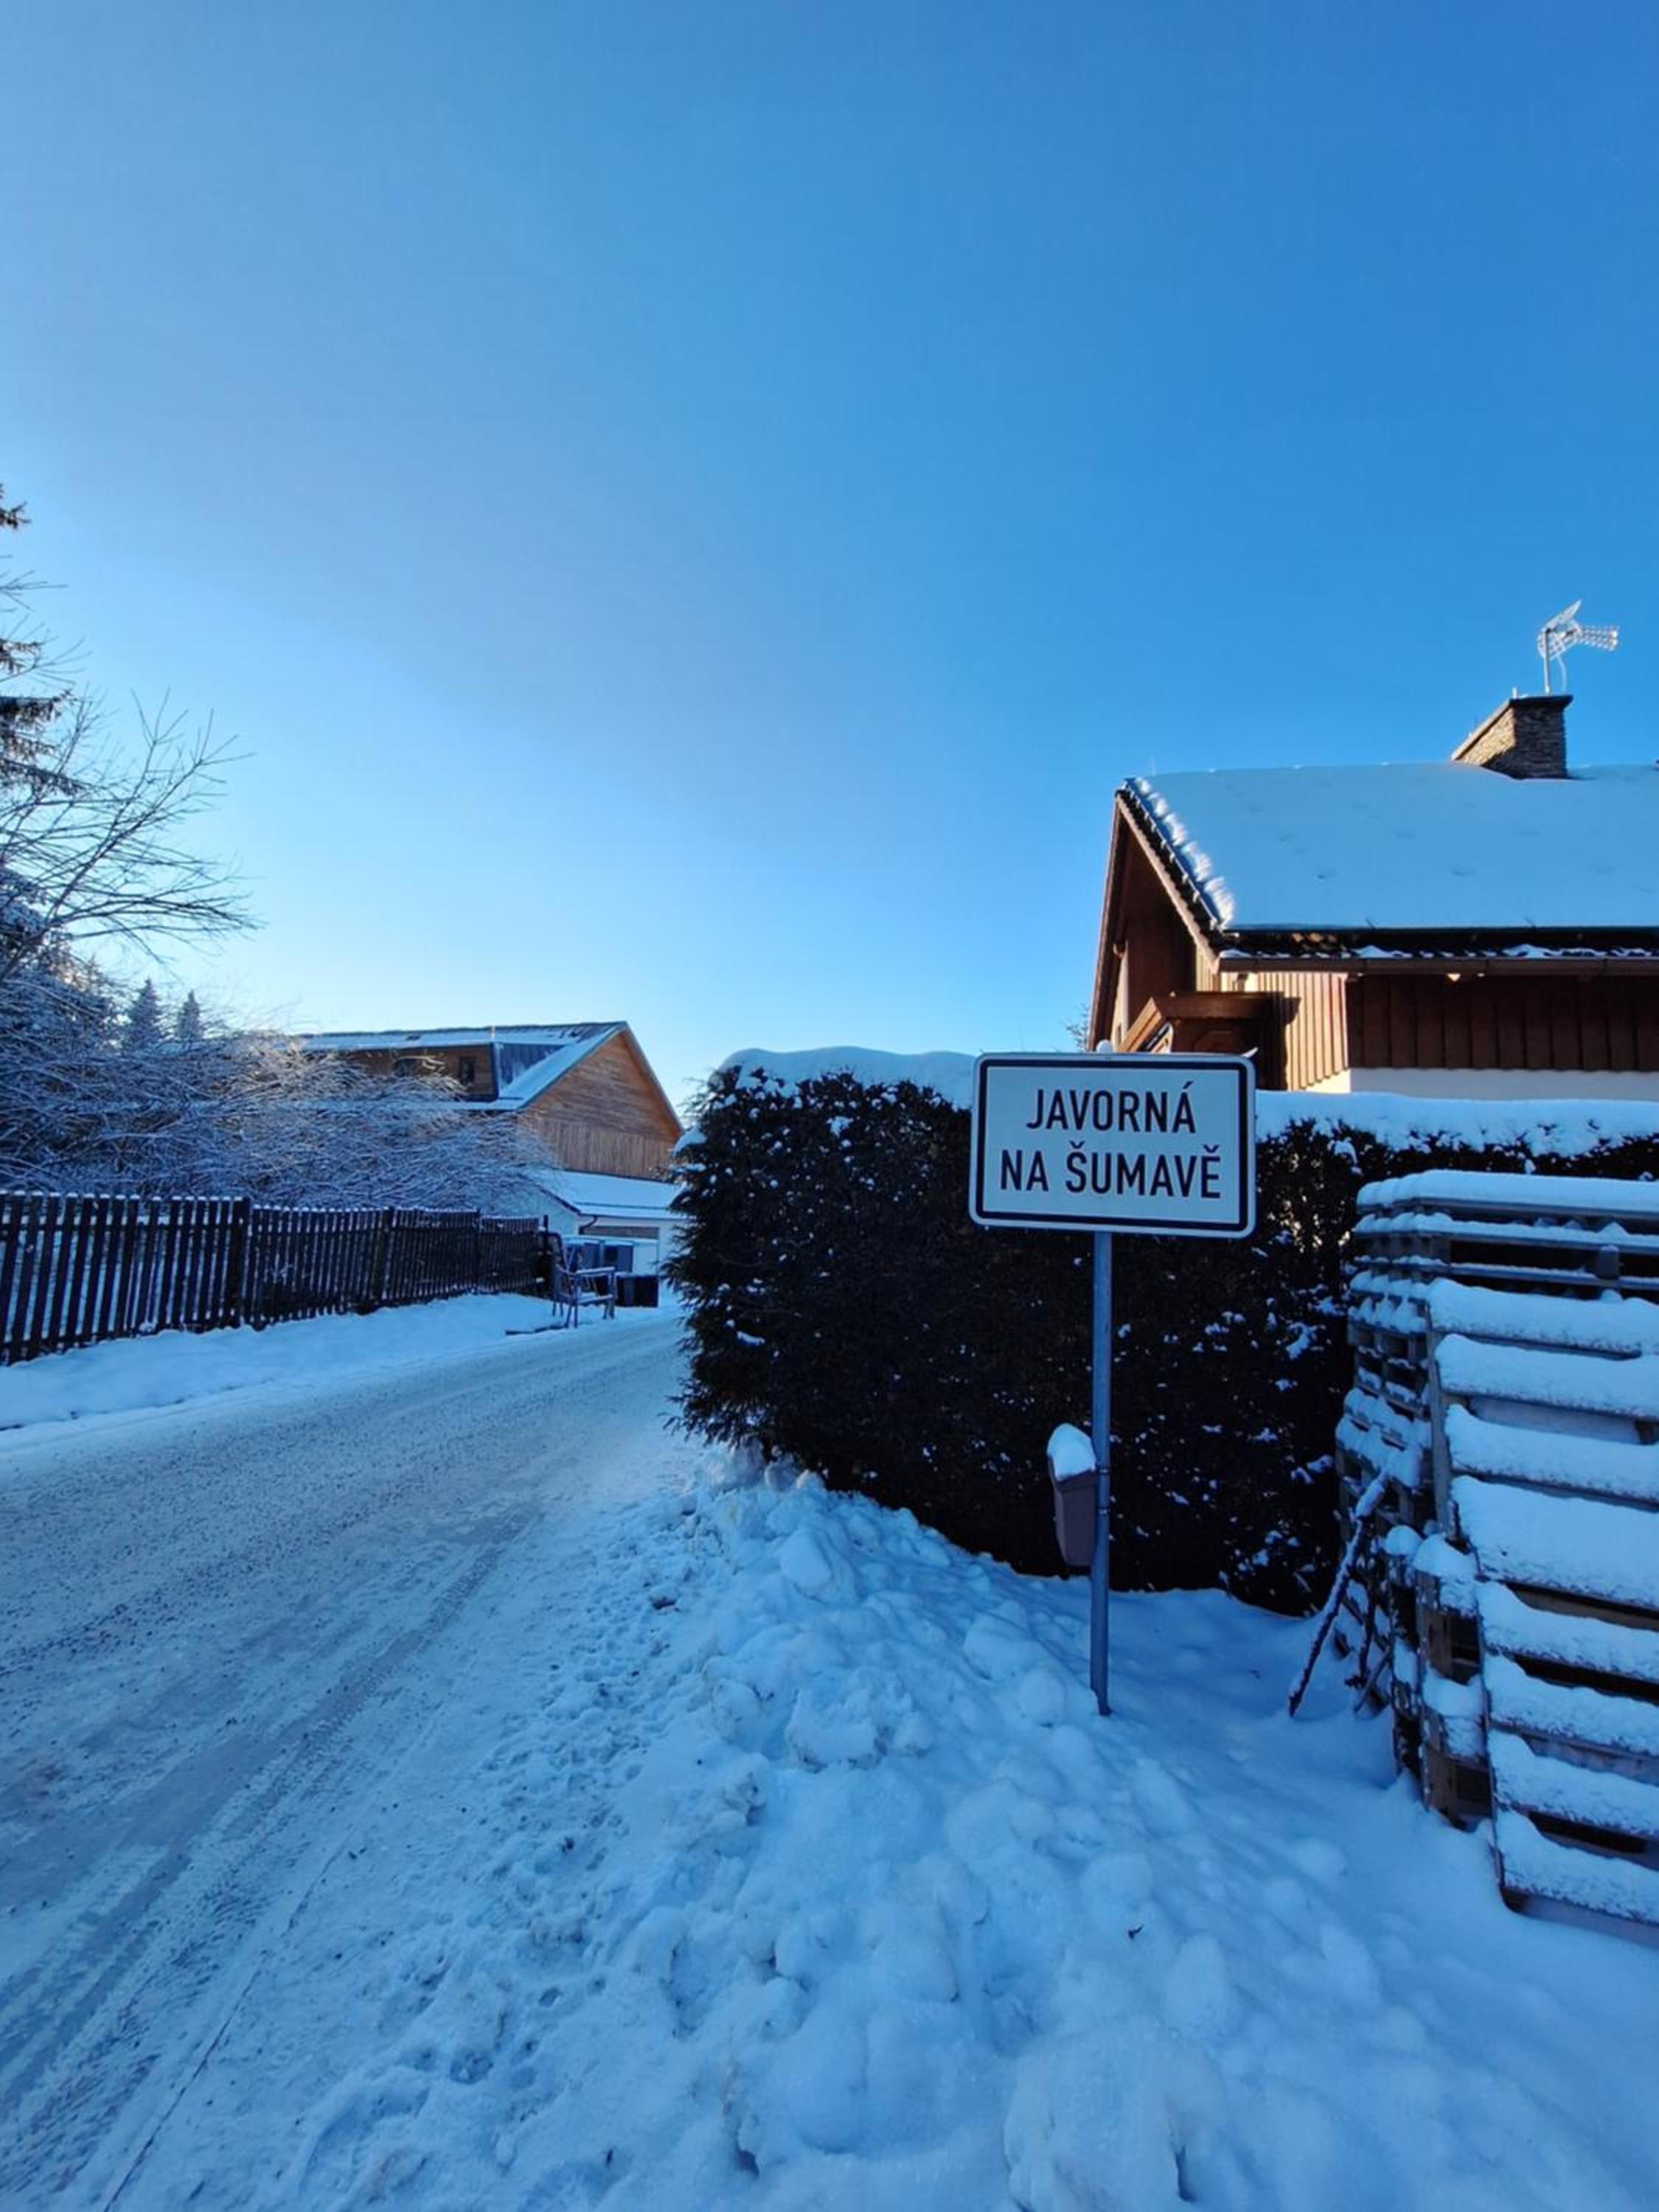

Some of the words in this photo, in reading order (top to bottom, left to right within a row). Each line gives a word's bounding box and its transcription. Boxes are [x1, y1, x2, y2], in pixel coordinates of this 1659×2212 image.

[1026, 1081, 1196, 1133] JAVORNÁ
[1001, 1150, 1048, 1192] NA
[1065, 1141, 1221, 1199] ŠUMAVĚ
